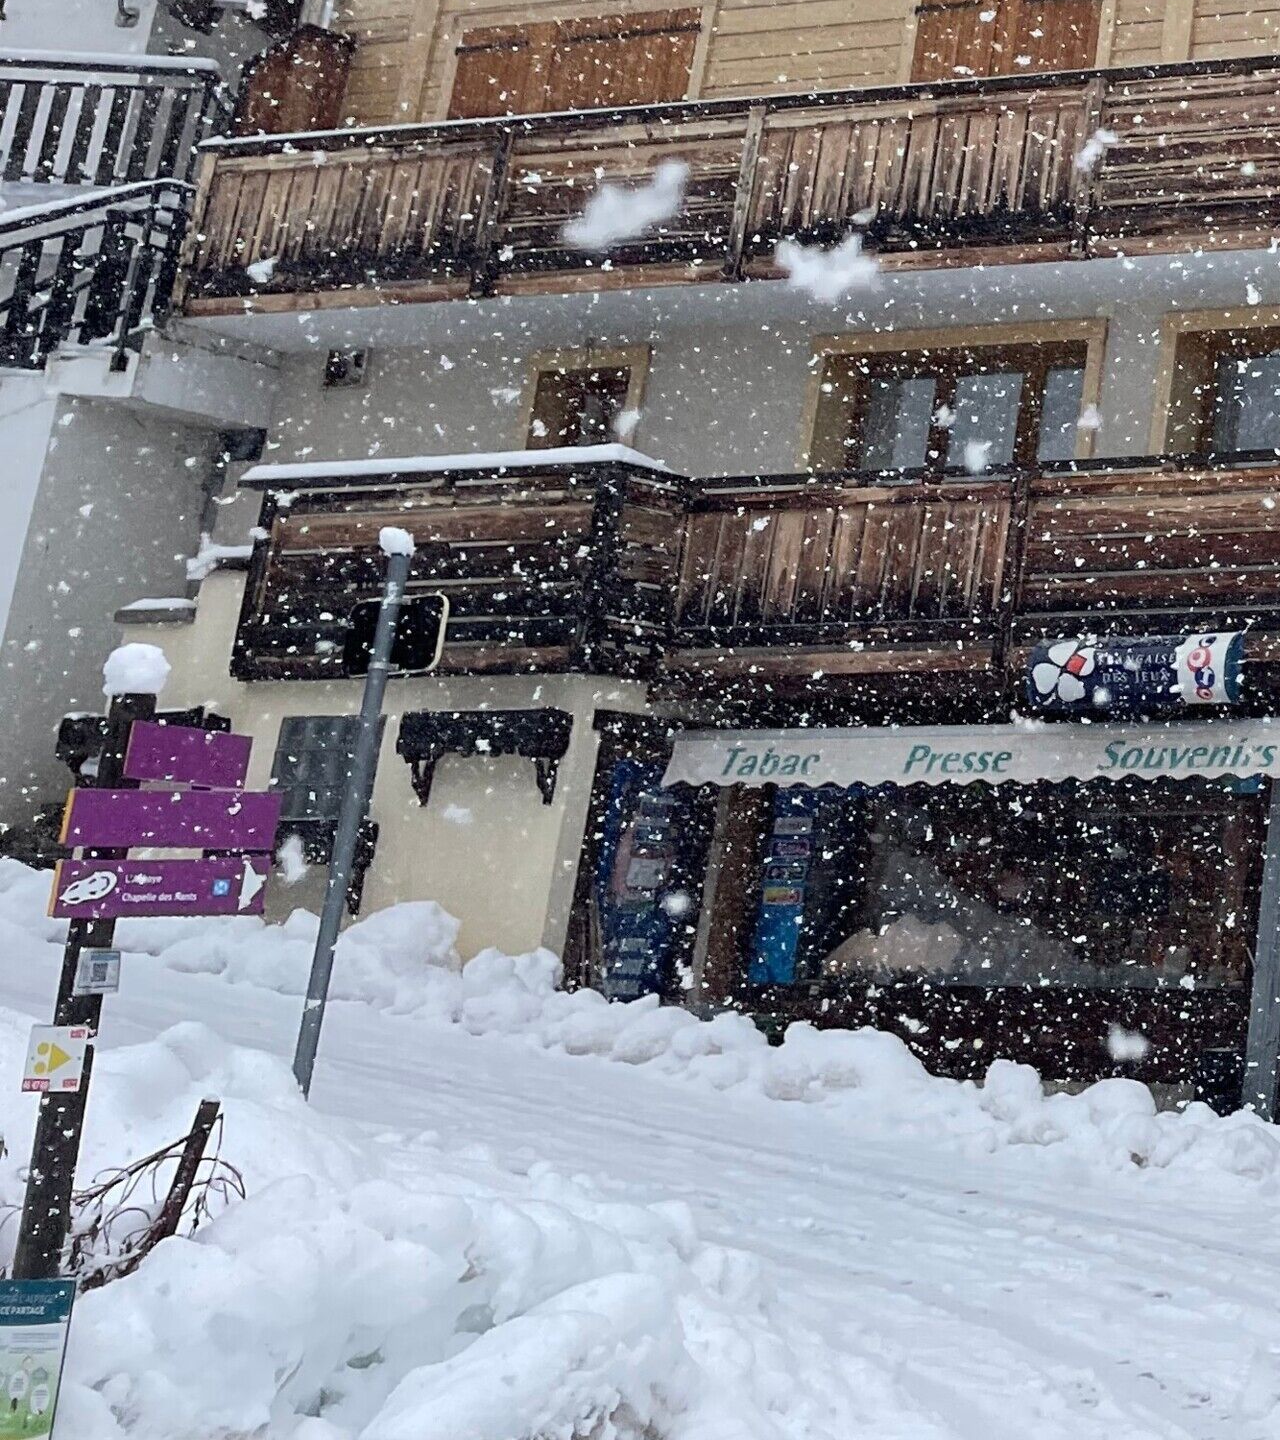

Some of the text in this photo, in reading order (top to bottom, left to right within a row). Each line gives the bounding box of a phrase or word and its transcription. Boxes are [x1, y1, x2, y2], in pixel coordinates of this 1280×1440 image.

[1134, 670, 1170, 684] JEUX
[721, 746, 820, 776] Tabac
[903, 745, 1012, 774] Presse
[1097, 738, 1278, 770] Souvenirs
[121, 892, 157, 903] Chapelle
[158, 892, 172, 902] des
